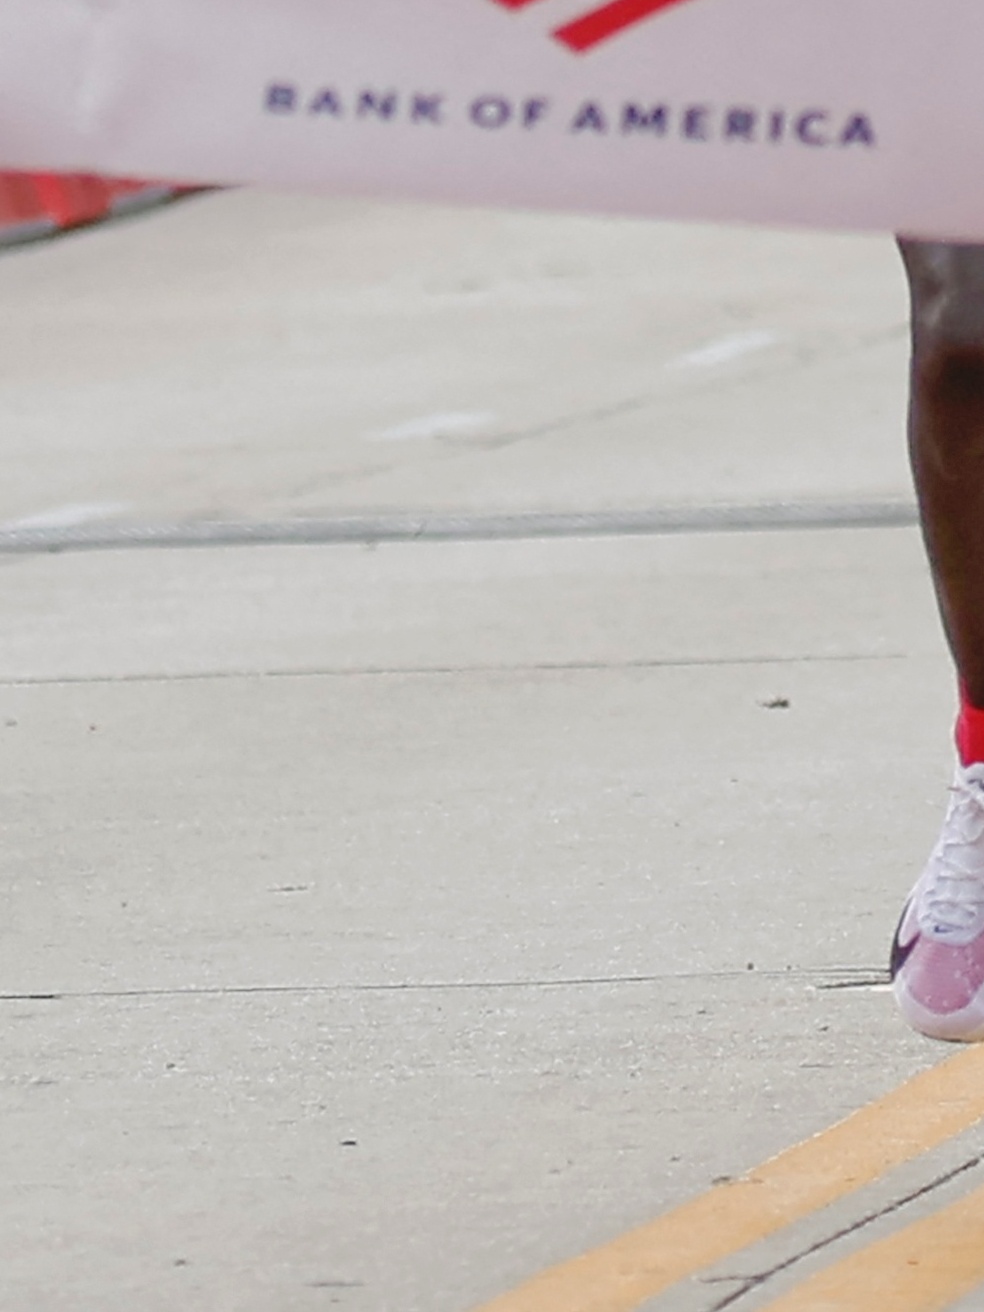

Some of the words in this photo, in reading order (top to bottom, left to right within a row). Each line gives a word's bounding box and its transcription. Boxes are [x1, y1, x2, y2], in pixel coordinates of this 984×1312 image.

[265, 83, 443, 122] BANK
[469, 95, 549, 129] OF
[571, 101, 876, 148] AMERICA
